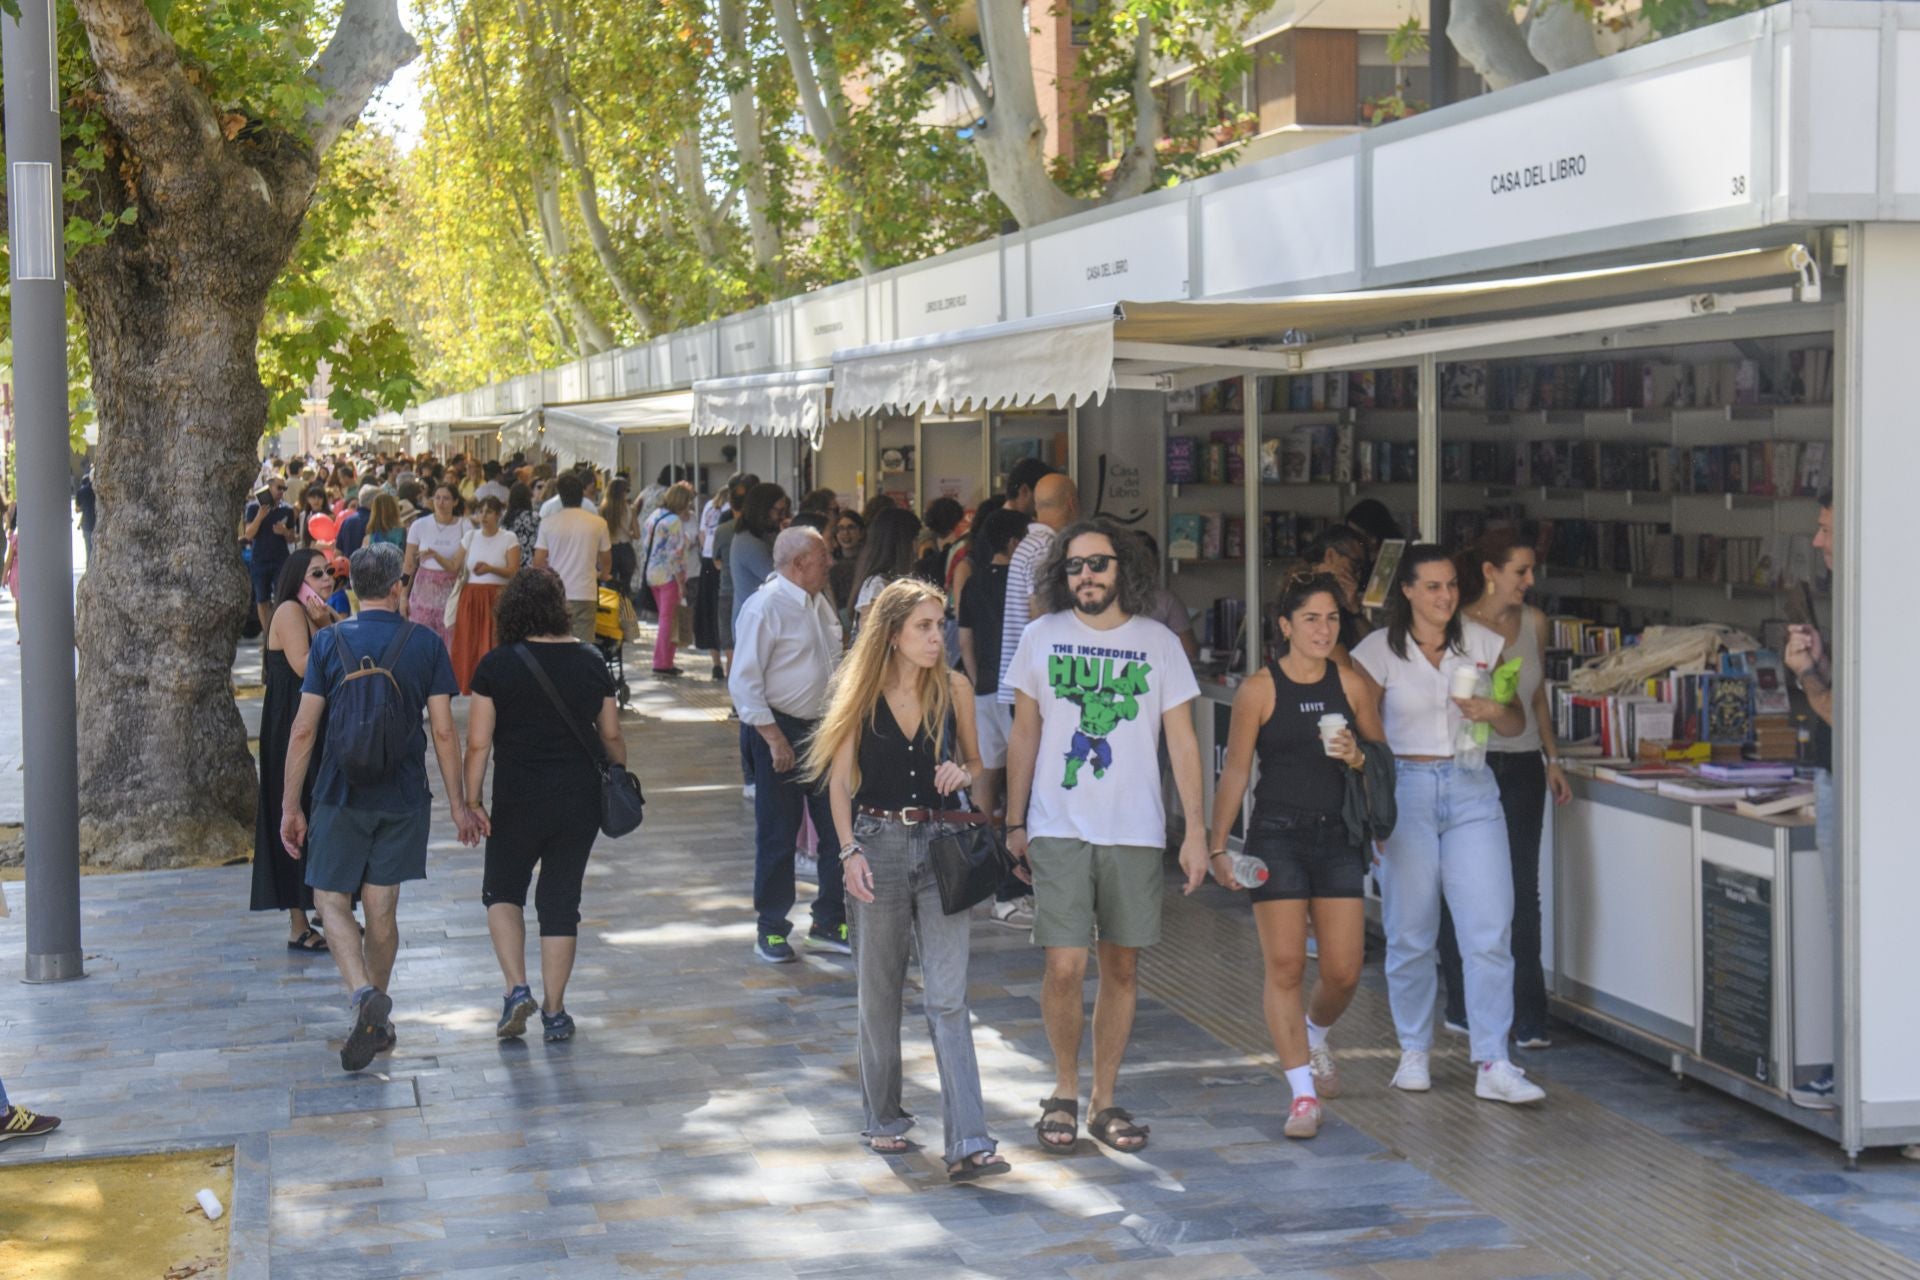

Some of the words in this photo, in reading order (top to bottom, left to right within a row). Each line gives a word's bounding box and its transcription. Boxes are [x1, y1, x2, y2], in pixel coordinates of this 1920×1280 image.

[1490, 170, 1521, 195] CASA
[1524, 164, 1547, 188] DEL
[1549, 153, 1586, 182] LIBRO
[1731, 175, 1746, 196] 38
[1086, 265, 1100, 281] CASA
[1101, 262, 1112, 278] DEL
[1112, 258, 1128, 275] LIBRO
[1110, 463, 1138, 477] Casa
[1109, 486, 1140, 498] Libro
[1052, 644, 1073, 654] THE
[1077, 645, 1148, 662] INCREDIBLE
[1048, 654, 1153, 696] HULK
